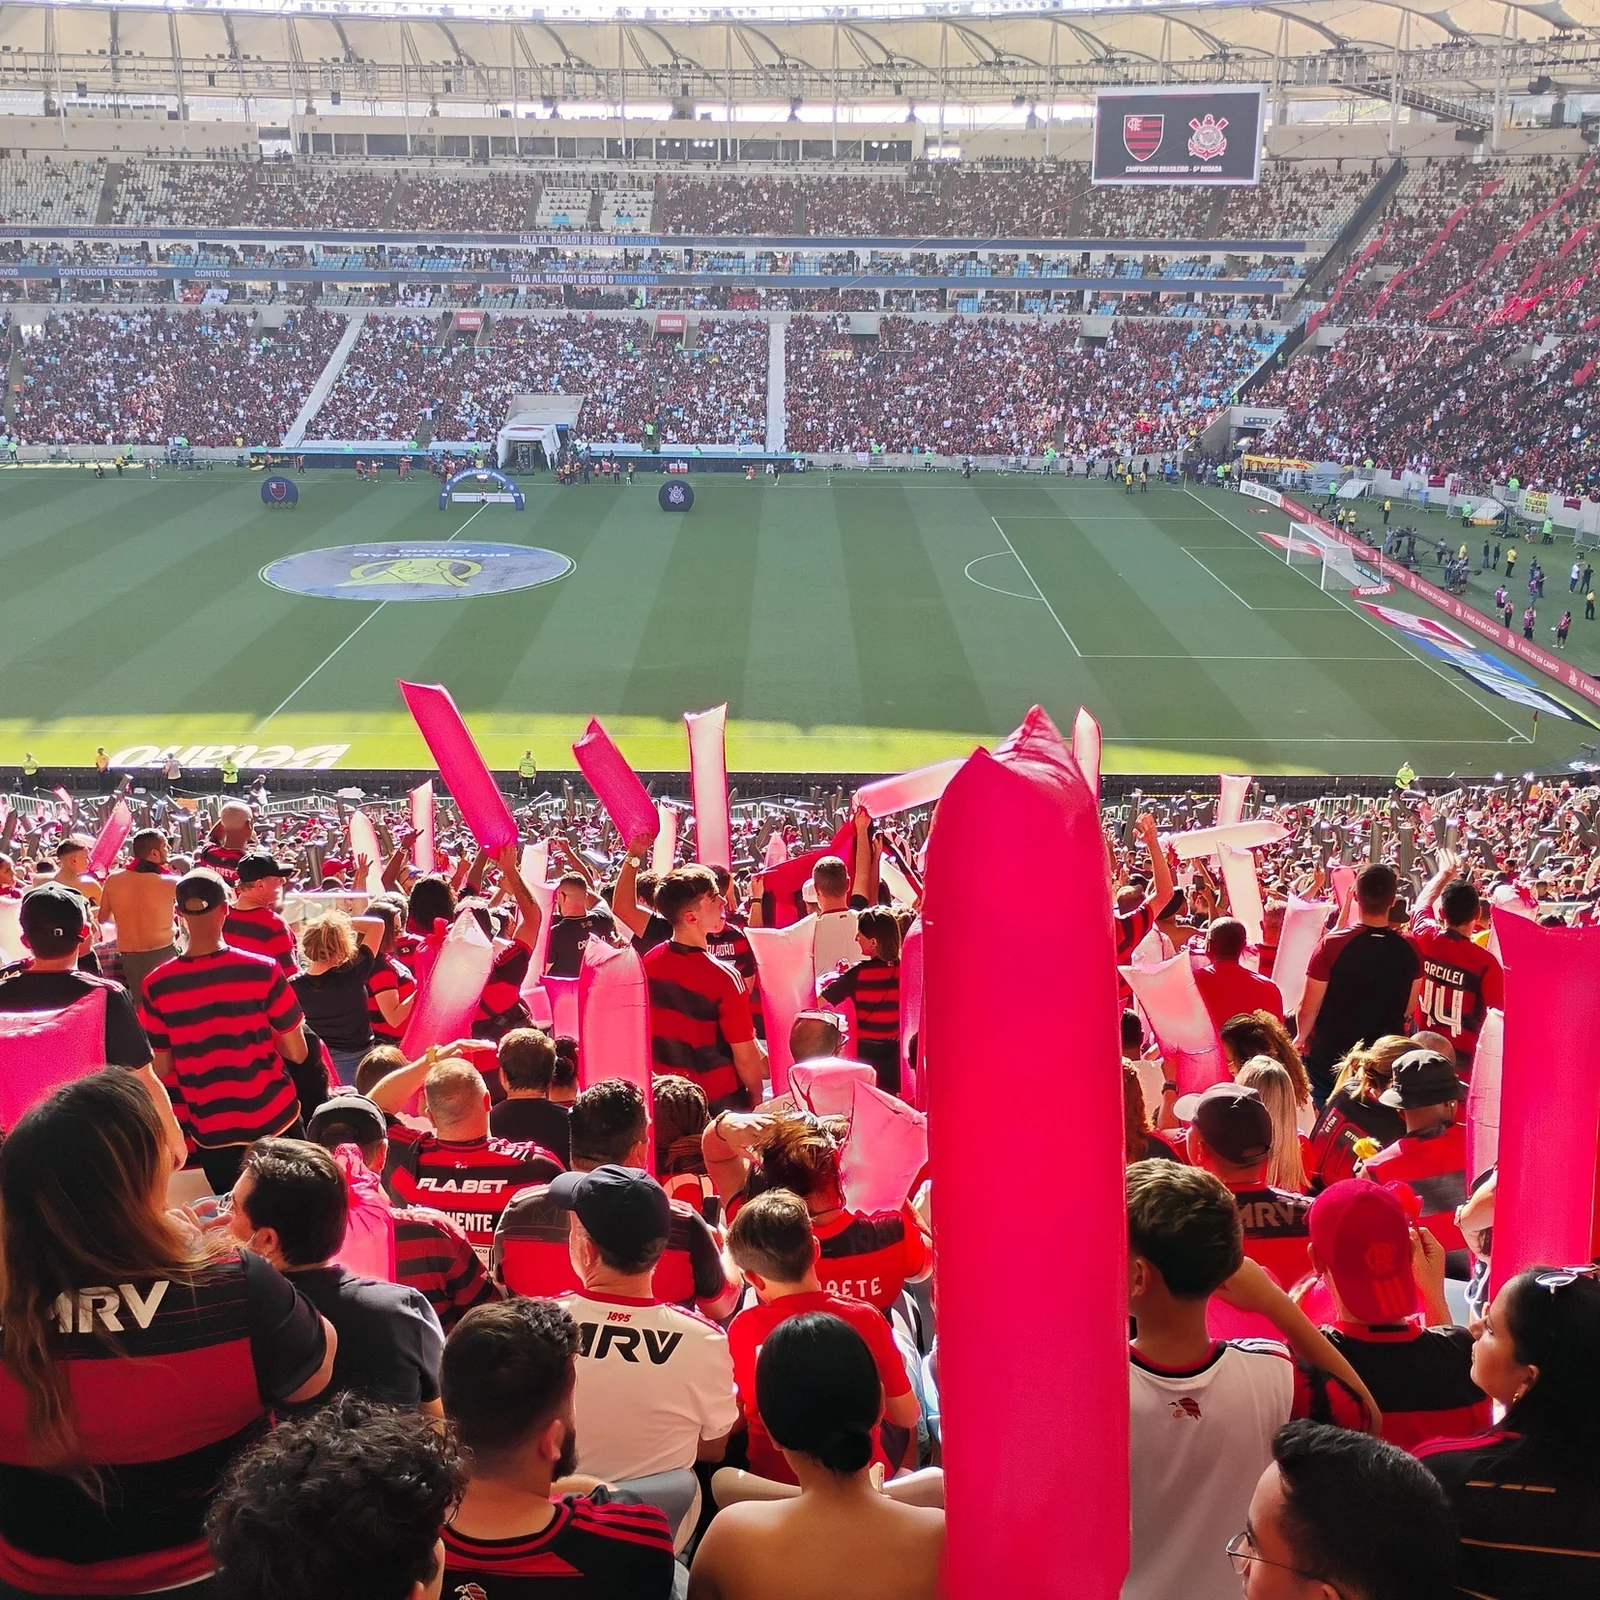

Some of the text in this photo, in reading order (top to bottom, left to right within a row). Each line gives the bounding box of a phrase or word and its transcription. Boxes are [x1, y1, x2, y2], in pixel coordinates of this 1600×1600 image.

[1125, 165, 1159, 173] CAMPEONATO
[1159, 165, 1189, 173] BRASILEIRO
[1200, 165, 1223, 173] RODADA
[115, 229, 161, 238] EXCLUSIVOS
[519, 235, 538, 244] FALA
[581, 236, 592, 245] EU
[592, 236, 609, 245] SOU
[58, 266, 158, 277] CONTEÚDOS EXCLUSIVOS
[510, 274, 531, 284] FALA
[578, 274, 589, 284] EU
[590, 274, 607, 284] SOU
[1521, 645, 1531, 657] MAIS
[1543, 659, 1560, 673] CAMPO
[1584, 683, 1595, 695] MAIS
[416, 1177, 509, 1194] FLA.BET
[606, 1311, 632, 1323] 1895
